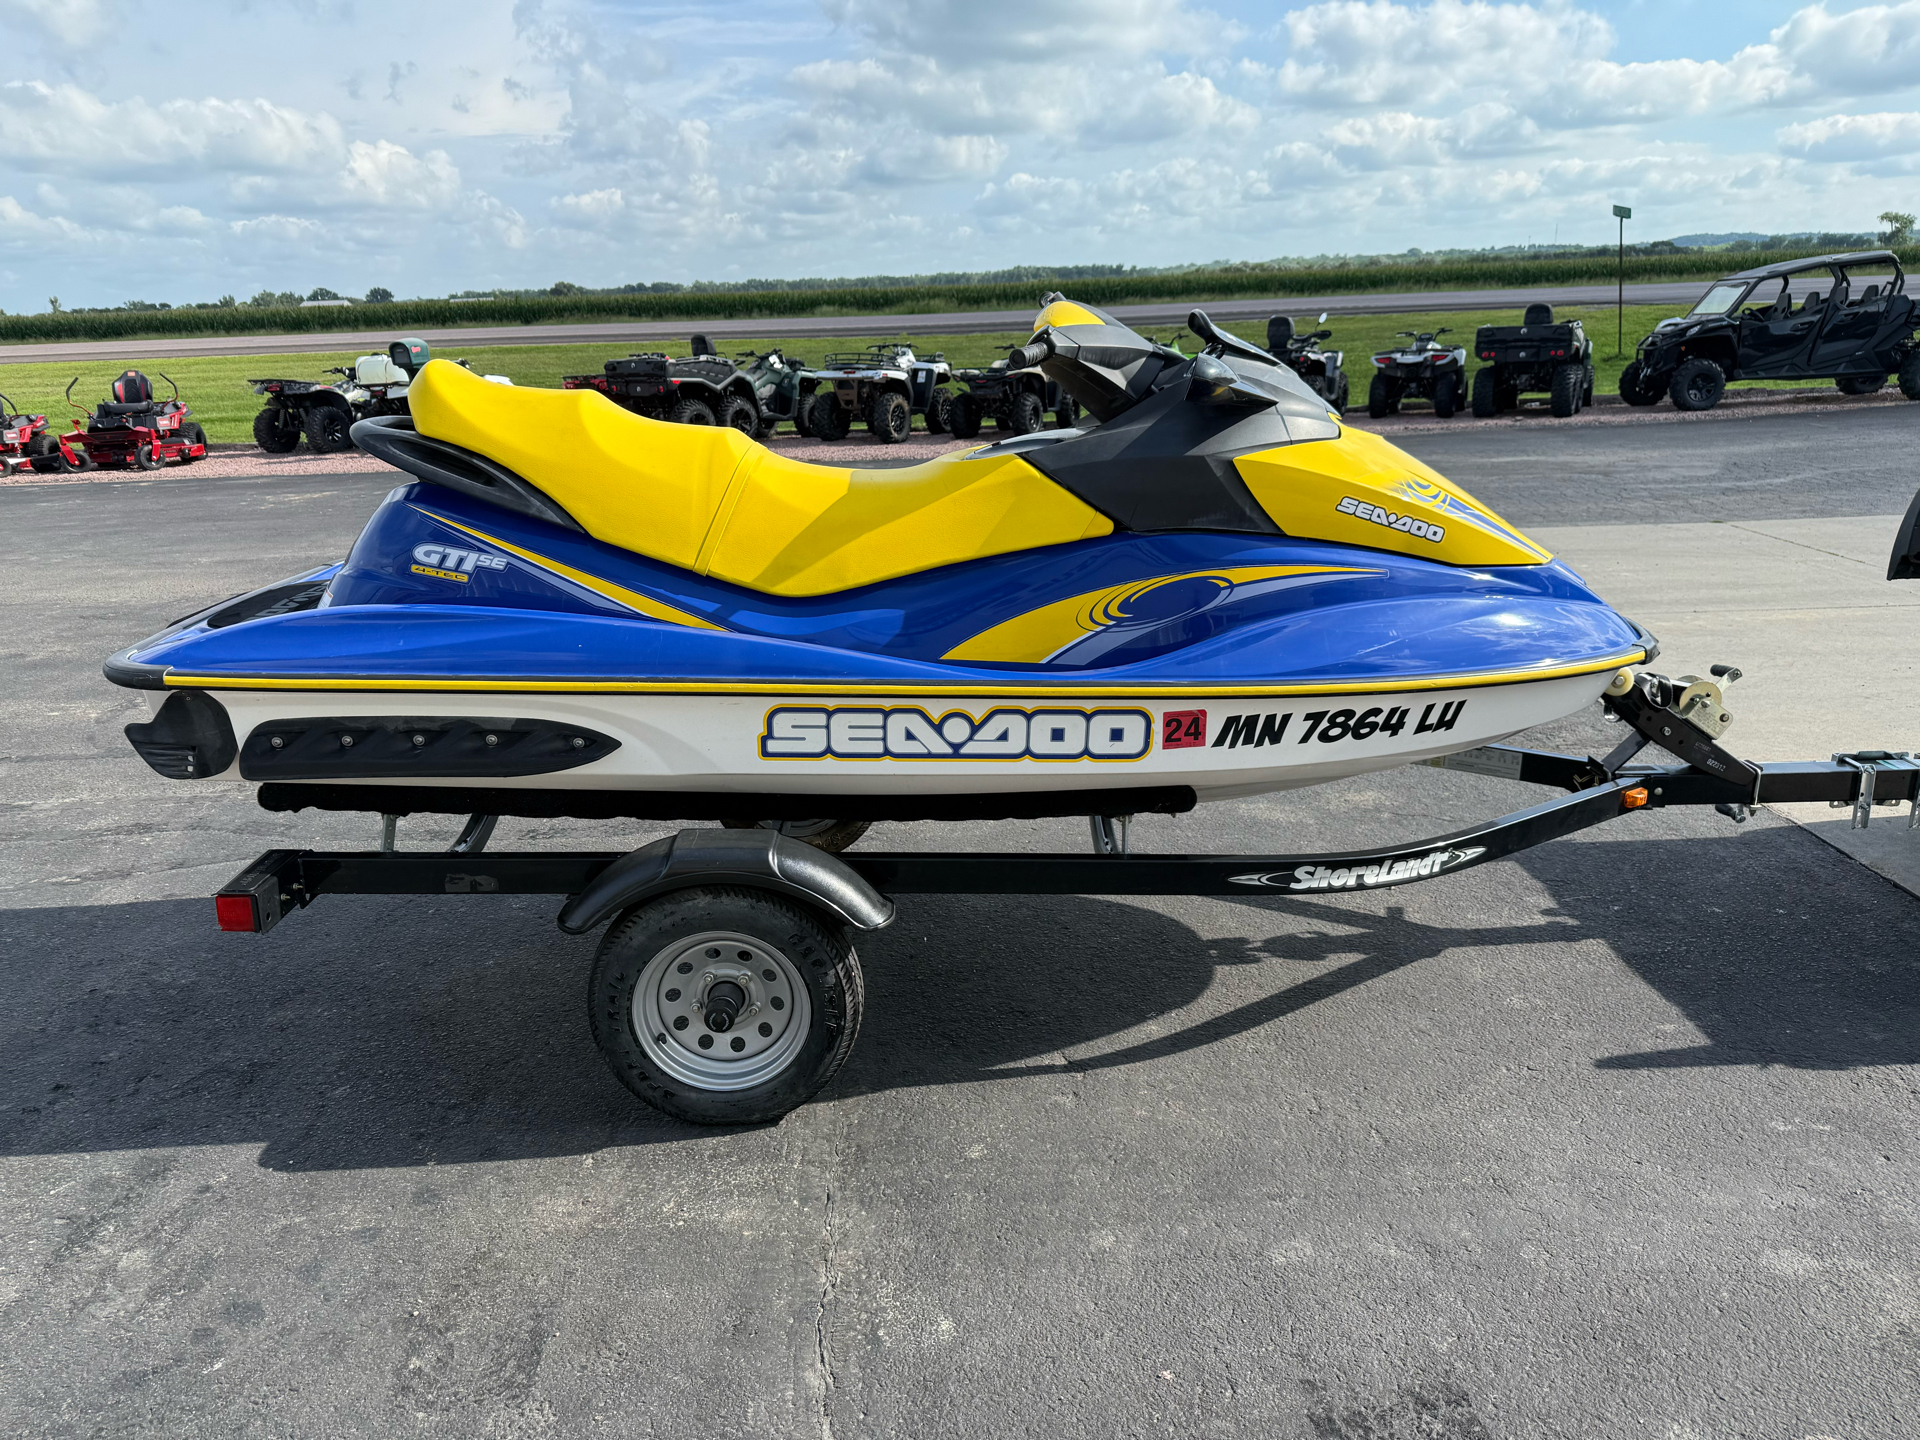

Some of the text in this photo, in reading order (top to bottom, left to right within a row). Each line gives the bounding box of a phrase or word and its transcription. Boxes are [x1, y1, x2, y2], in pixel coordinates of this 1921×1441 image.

[414, 566, 466, 581] 4-TEC
[1165, 716, 1202, 743] 24
[1210, 699, 1468, 749] MN 7864 LU
